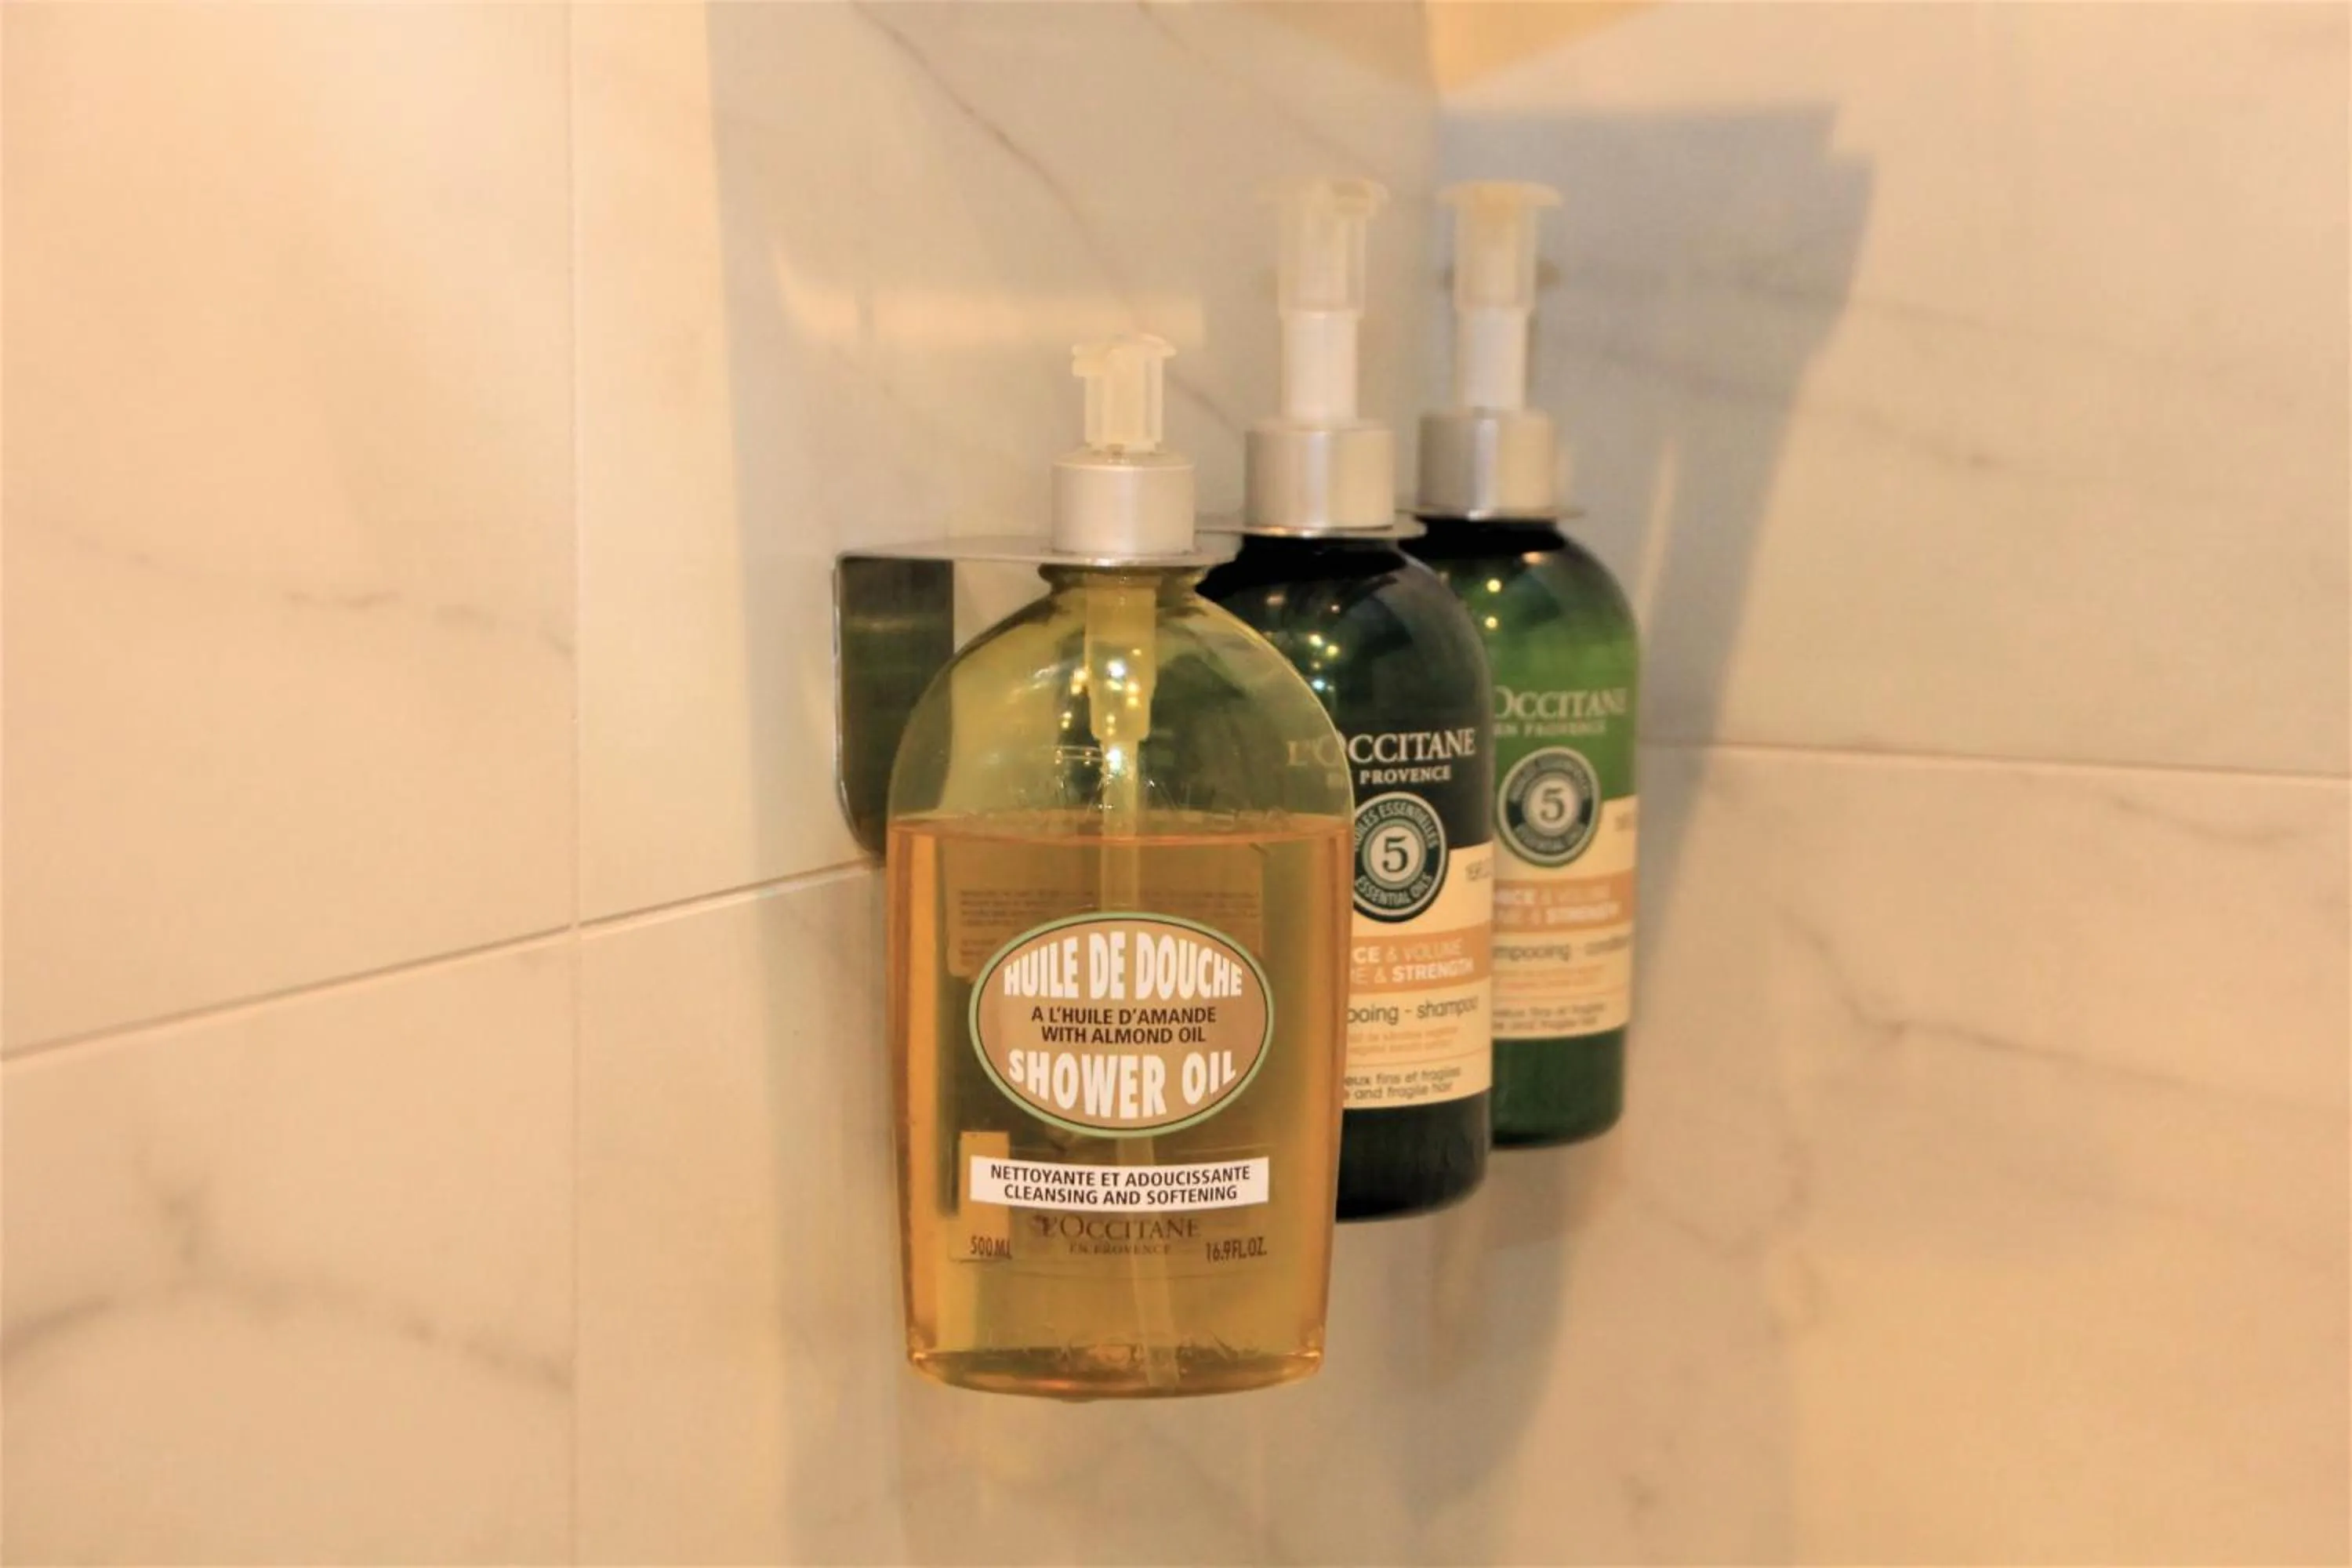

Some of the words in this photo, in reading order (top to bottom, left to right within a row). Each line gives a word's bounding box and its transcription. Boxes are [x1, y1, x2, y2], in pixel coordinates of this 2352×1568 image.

[1359, 765, 1451, 785] PROVENCE
[1540, 787, 1565, 822] 5
[1382, 836, 1408, 873] 5
[1004, 937, 1079, 998] HUILE
[1090, 931, 1126, 1000] DE
[1135, 931, 1243, 1000] DOUCHE
[1392, 957, 1475, 983] STRENGTH
[1031, 1006, 1044, 1022] A
[1049, 1007, 1113, 1025] L'HUILE
[1120, 1007, 1217, 1025] D'AMANDE
[1041, 1026, 1087, 1044] WITH
[1091, 1026, 1173, 1044] ALMOND
[1178, 1026, 1207, 1044] OIL
[1008, 1048, 1167, 1120] SHOWER
[1181, 1050, 1236, 1105] OIL
[1354, 1087, 1382, 1100] and
[990, 1163, 1095, 1187] NETTOYANTE
[1101, 1172, 1121, 1187] ET
[1124, 1165, 1250, 1188] ADOUCISSANTE
[1004, 1185, 1098, 1205] CLEANSING
[1103, 1191, 1141, 1205] AND
[1146, 1185, 1238, 1205] SOFTENING
